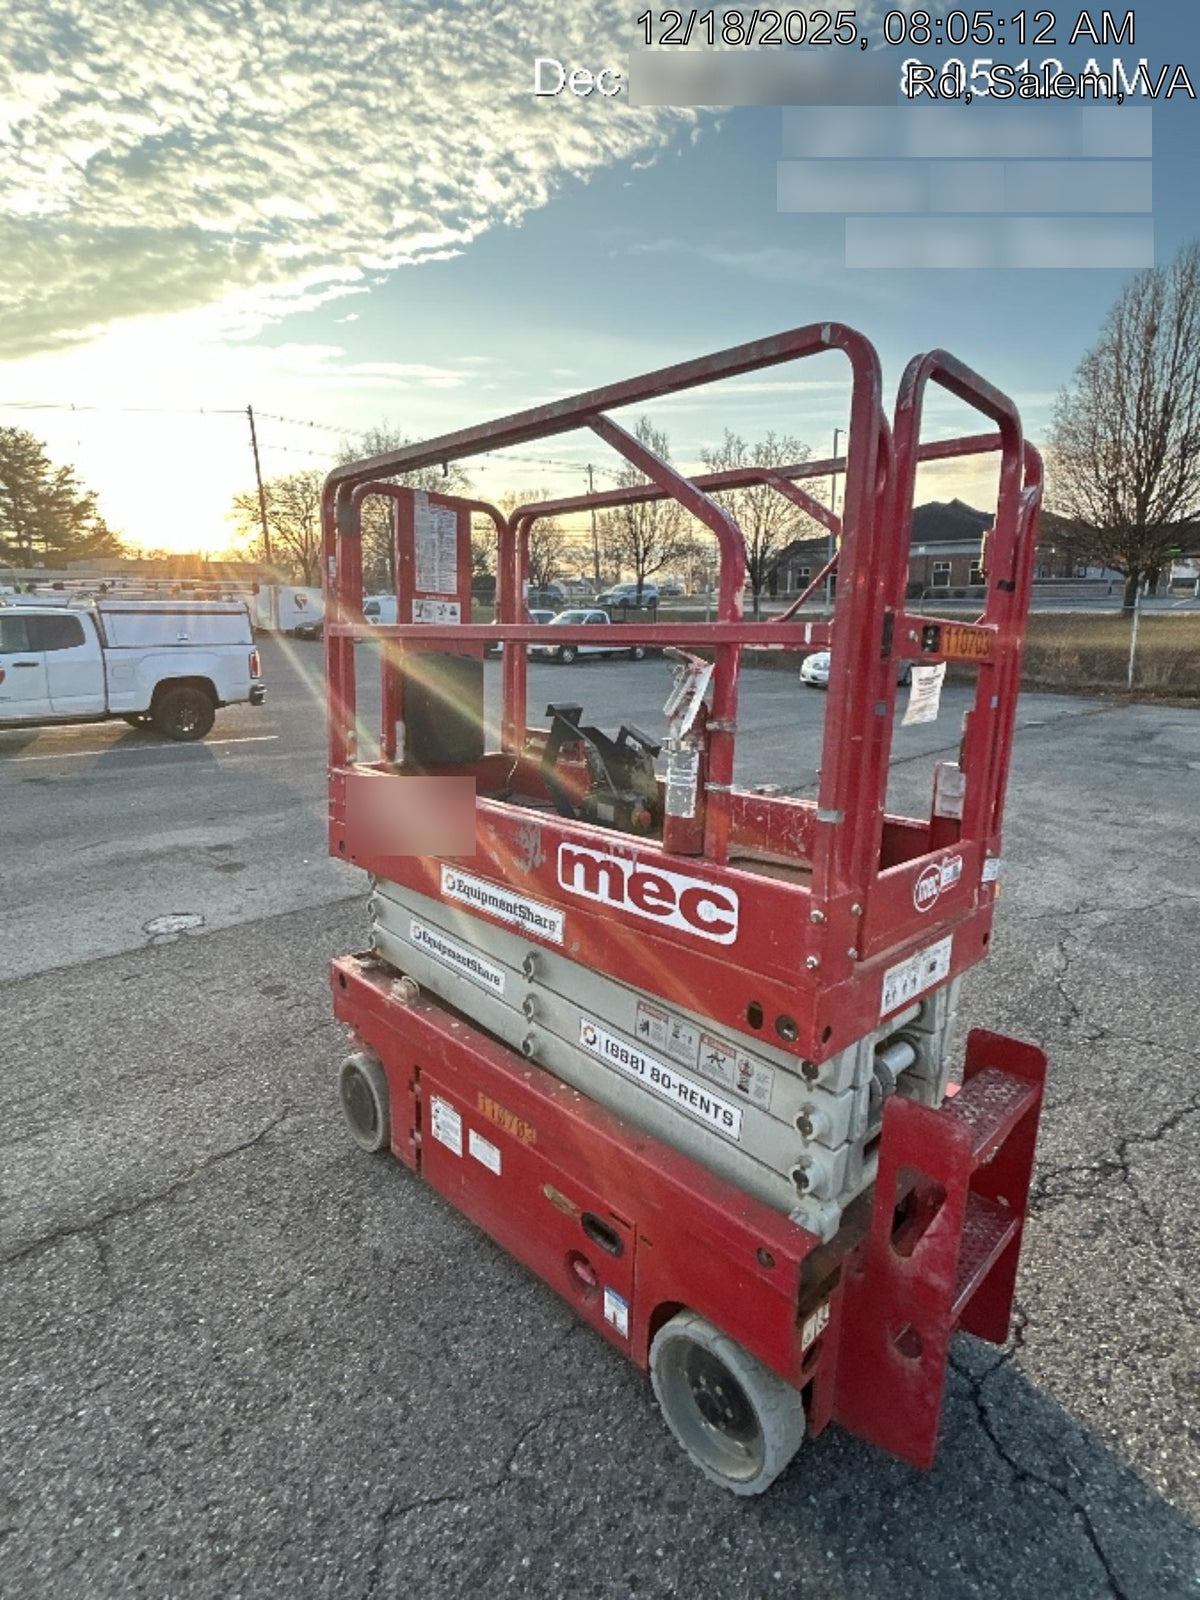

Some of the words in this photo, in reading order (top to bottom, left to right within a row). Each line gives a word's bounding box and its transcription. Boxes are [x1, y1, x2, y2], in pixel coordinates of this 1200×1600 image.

[457, 879, 557, 932] EquipmentShare
[562, 848, 735, 935] mec
[422, 931, 501, 986] EquipmentShare
[605, 1039, 646, 1075] (888)
[650, 1065, 734, 1128] 80-RENTS
